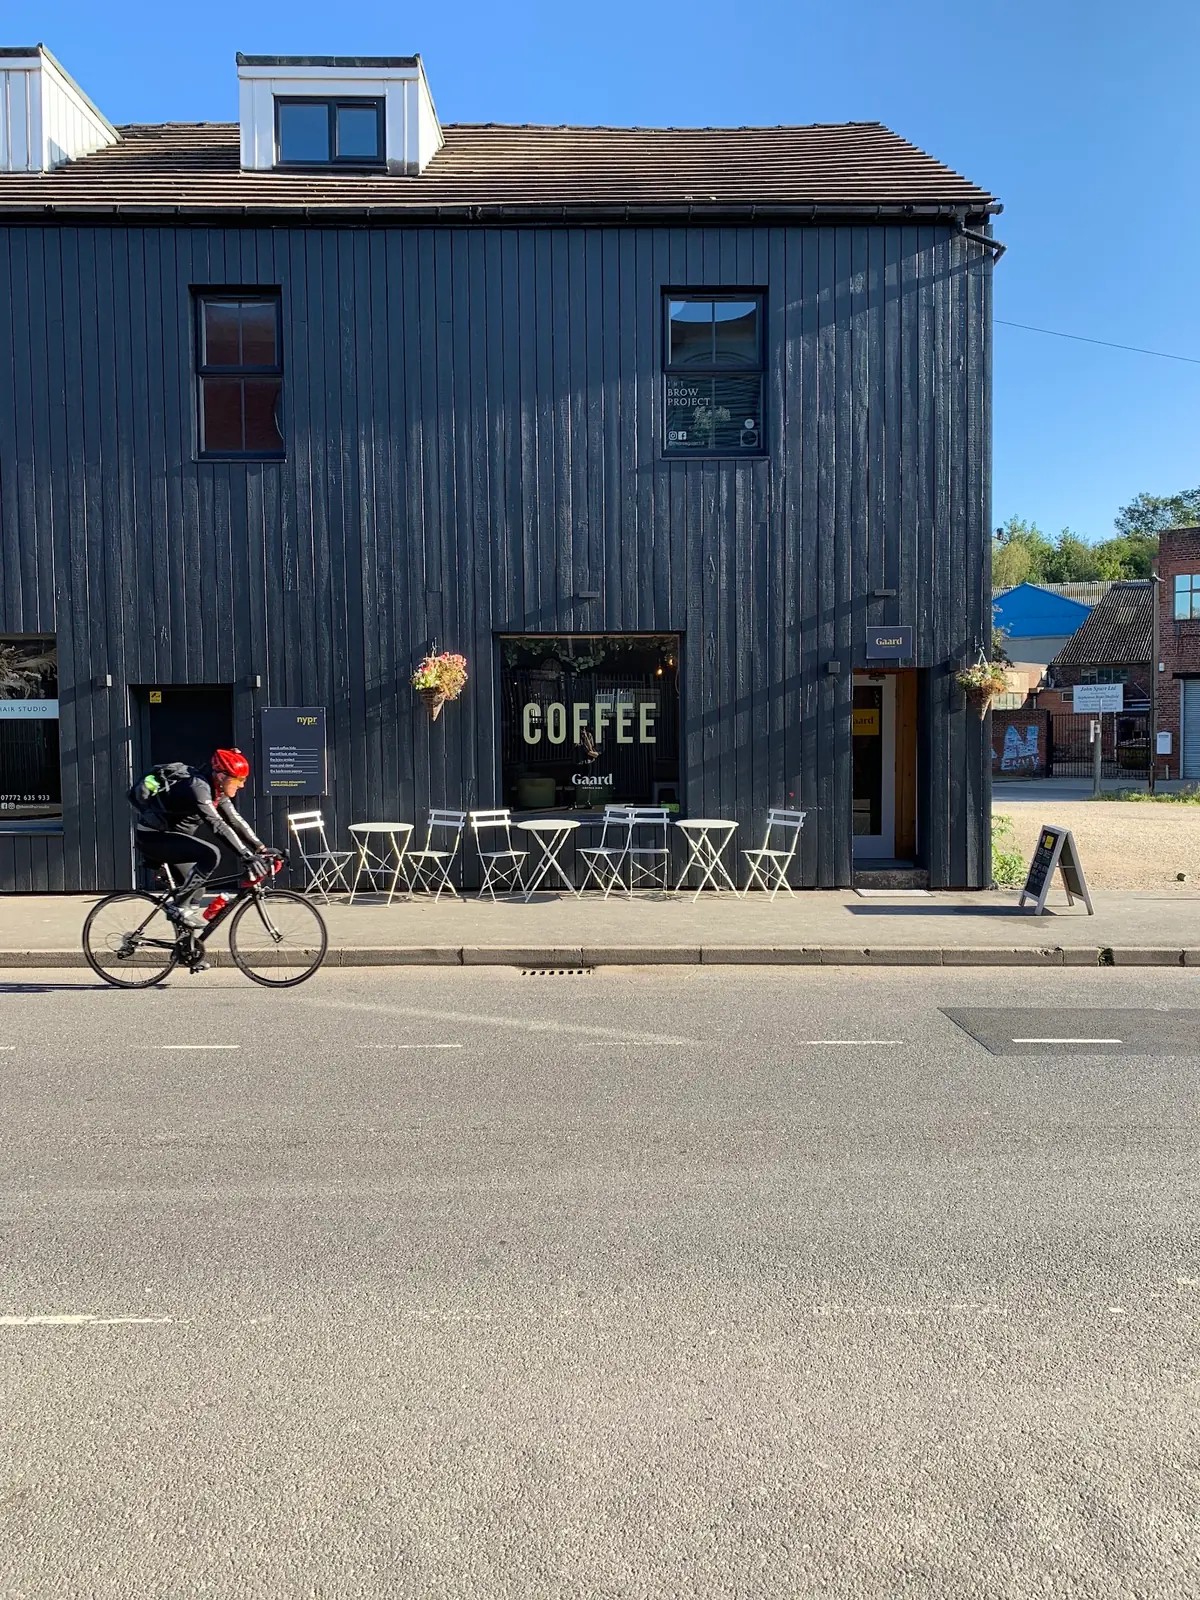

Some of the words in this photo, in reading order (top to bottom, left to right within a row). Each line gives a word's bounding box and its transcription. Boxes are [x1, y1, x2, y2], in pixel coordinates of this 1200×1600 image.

[667, 388, 699, 397] BROW
[667, 398, 711, 407] PROJECT
[875, 637, 903, 646] Gaard
[296, 716, 318, 726] nypr
[523, 702, 656, 744] COFFEE
[571, 773, 613, 786] Gaard
